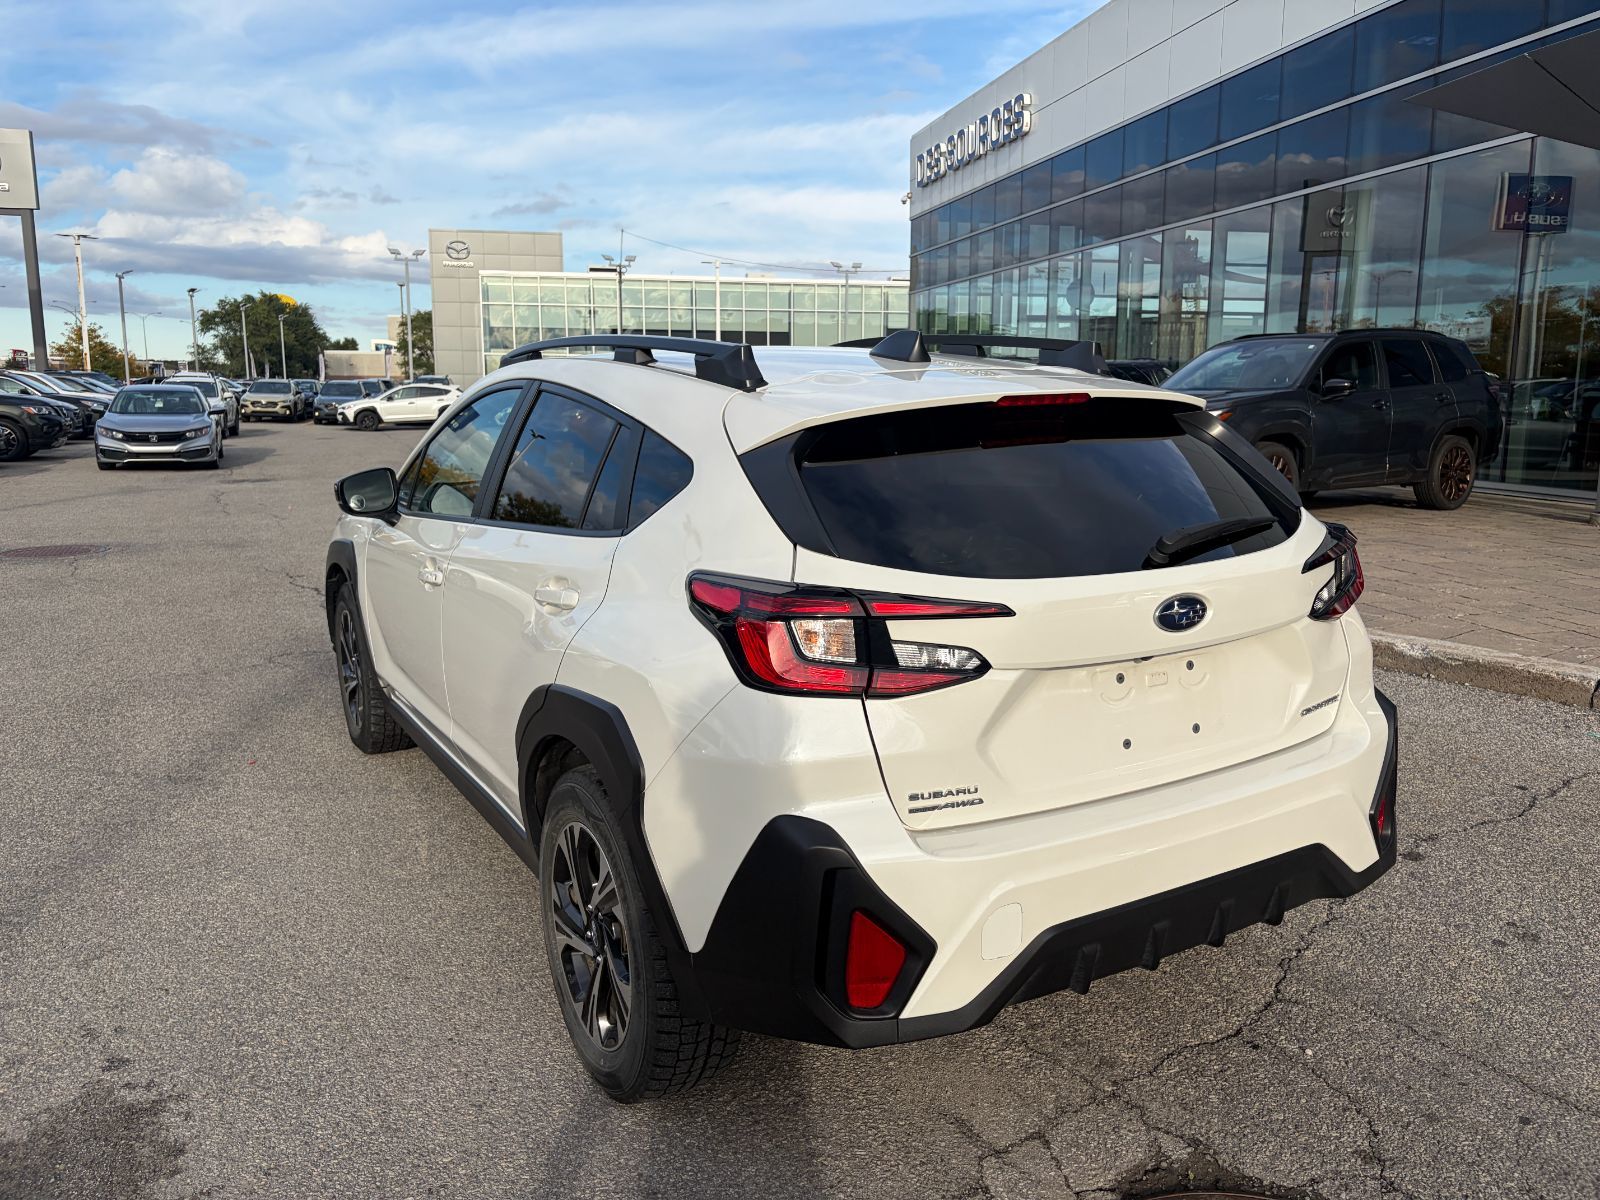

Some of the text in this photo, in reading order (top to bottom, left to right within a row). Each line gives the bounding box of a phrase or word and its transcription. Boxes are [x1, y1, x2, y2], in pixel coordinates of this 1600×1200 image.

[917, 93, 1032, 188] DES SOURCES
[908, 785, 979, 801] SUBARU
